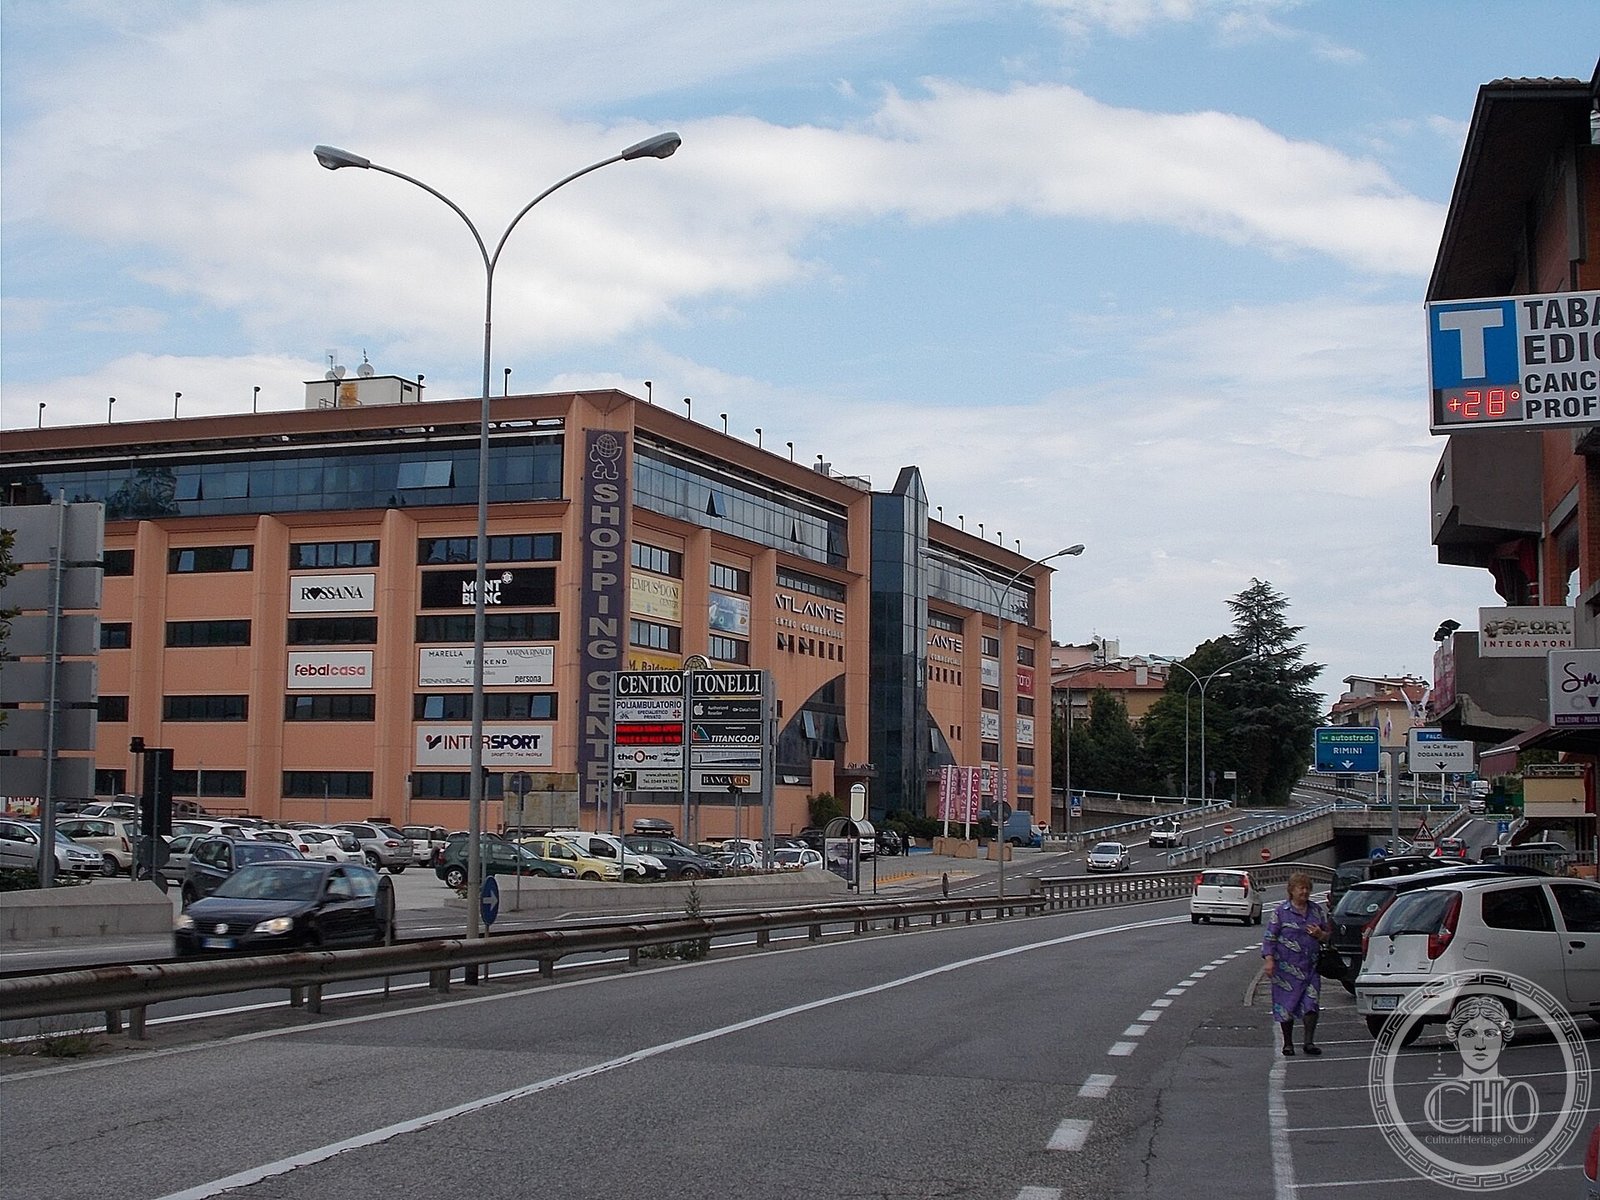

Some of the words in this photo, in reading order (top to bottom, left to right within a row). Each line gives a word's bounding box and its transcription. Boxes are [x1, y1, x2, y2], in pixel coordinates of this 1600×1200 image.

[1525, 370, 1600, 394] CANC
[587, 483, 621, 659] SHOPPING
[462, 592, 502, 605] BLNC
[1483, 640, 1572, 648] INTEGRATORI
[428, 650, 464, 658] MARELLA
[514, 674, 542, 684] persona
[618, 674, 682, 693] CENTRO
[694, 673, 760, 693] TONELLI
[616, 700, 682, 709] POLIAMBULATORIO
[444, 734, 541, 750] INTRSPORT
[711, 735, 760, 743] TITANCOOP
[1330, 733, 1374, 742] autostrada
[702, 775, 732, 785] BANCA
